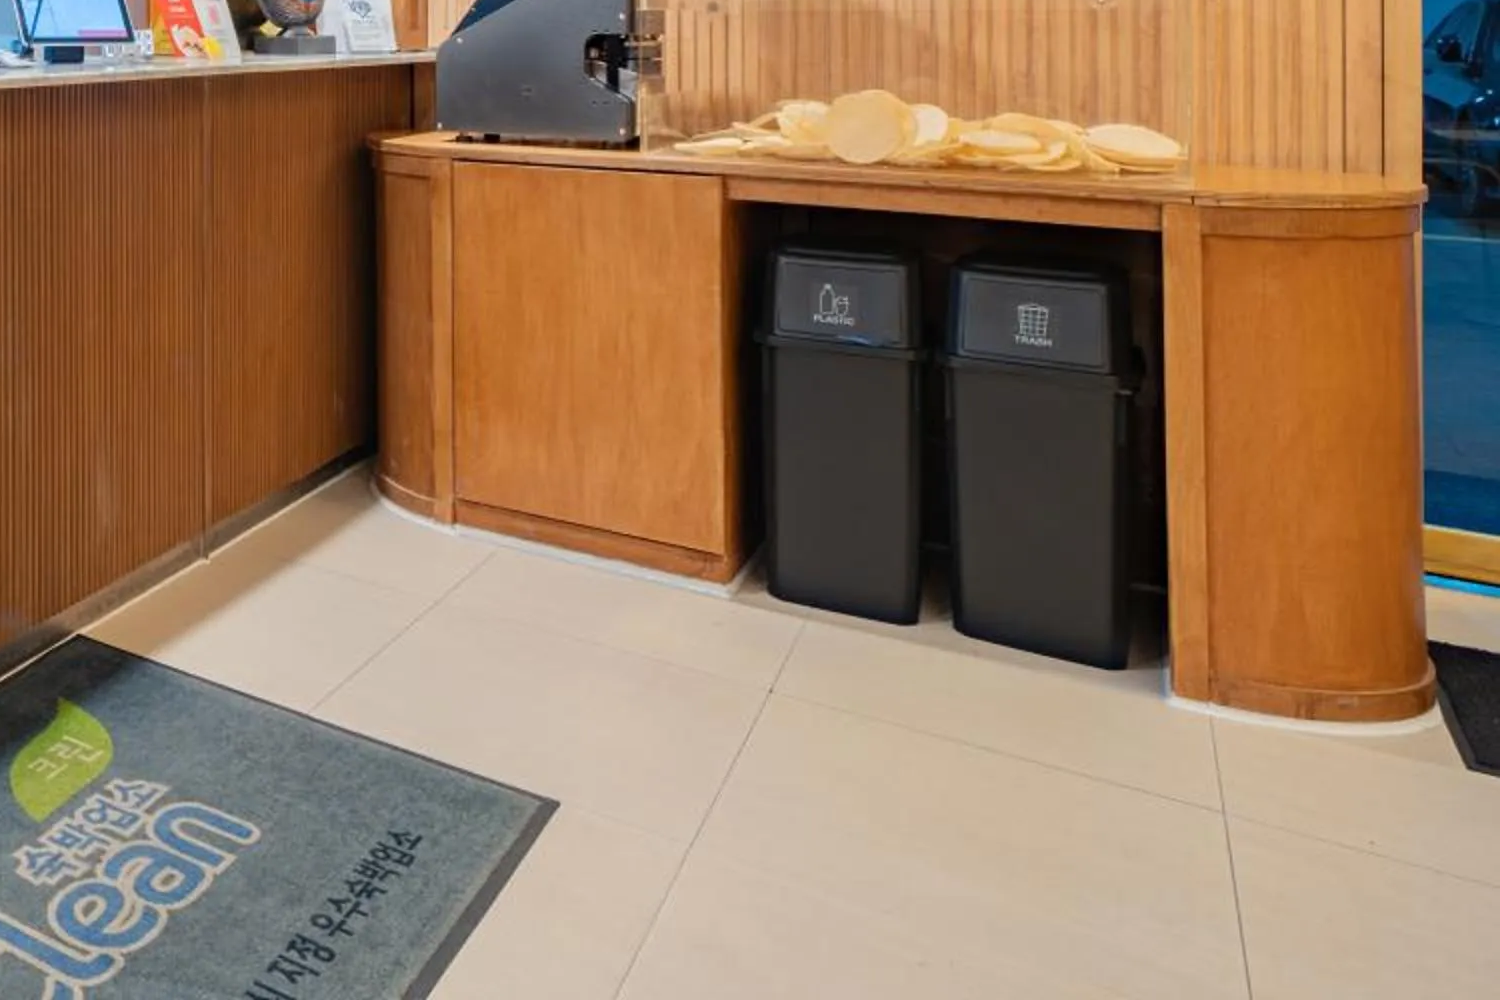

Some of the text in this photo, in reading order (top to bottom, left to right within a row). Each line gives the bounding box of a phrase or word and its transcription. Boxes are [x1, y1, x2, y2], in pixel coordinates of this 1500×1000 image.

[813, 312, 855, 327] PLASTIC
[1014, 333, 1053, 347] TRASH
[26, 734, 104, 780] 크린
[13, 779, 172, 886] 숙박업소
[266, 932, 336, 985] 지정
[309, 830, 424, 937] 우수숙박업소
